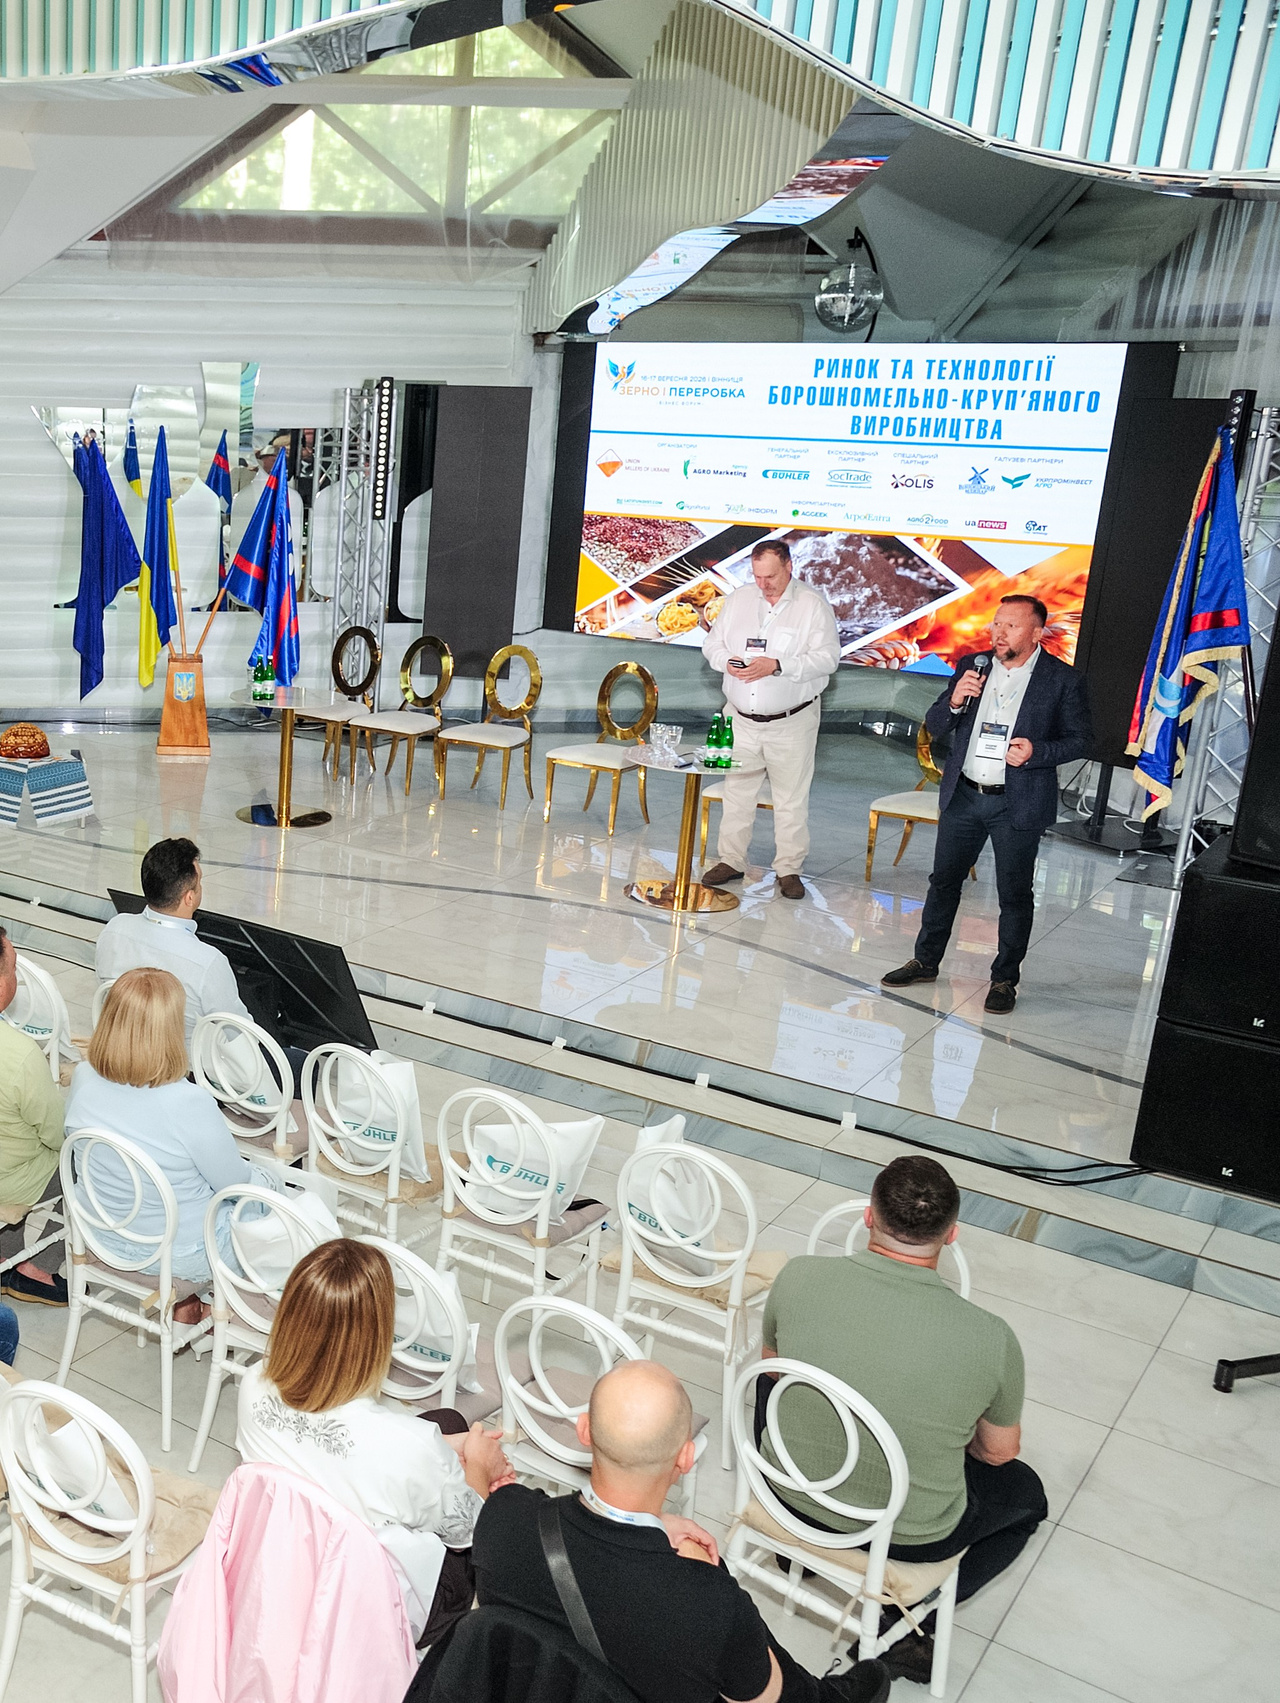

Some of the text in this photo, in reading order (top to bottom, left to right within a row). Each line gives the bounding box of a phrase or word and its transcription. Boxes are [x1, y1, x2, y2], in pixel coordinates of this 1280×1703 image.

[814, 356, 1055, 381] РИНОК ТА ТЕХНОЛОГІЇ
[619, 386, 660, 396] ЗЕРНО
[669, 387, 746, 398] ПЕРЕРОБКА
[768, 386, 1100, 413] БОРОШНОМЕЛЬНО-КРУП'ЯНОГО
[850, 416, 1002, 441] ВИРОБНИЦТВА
